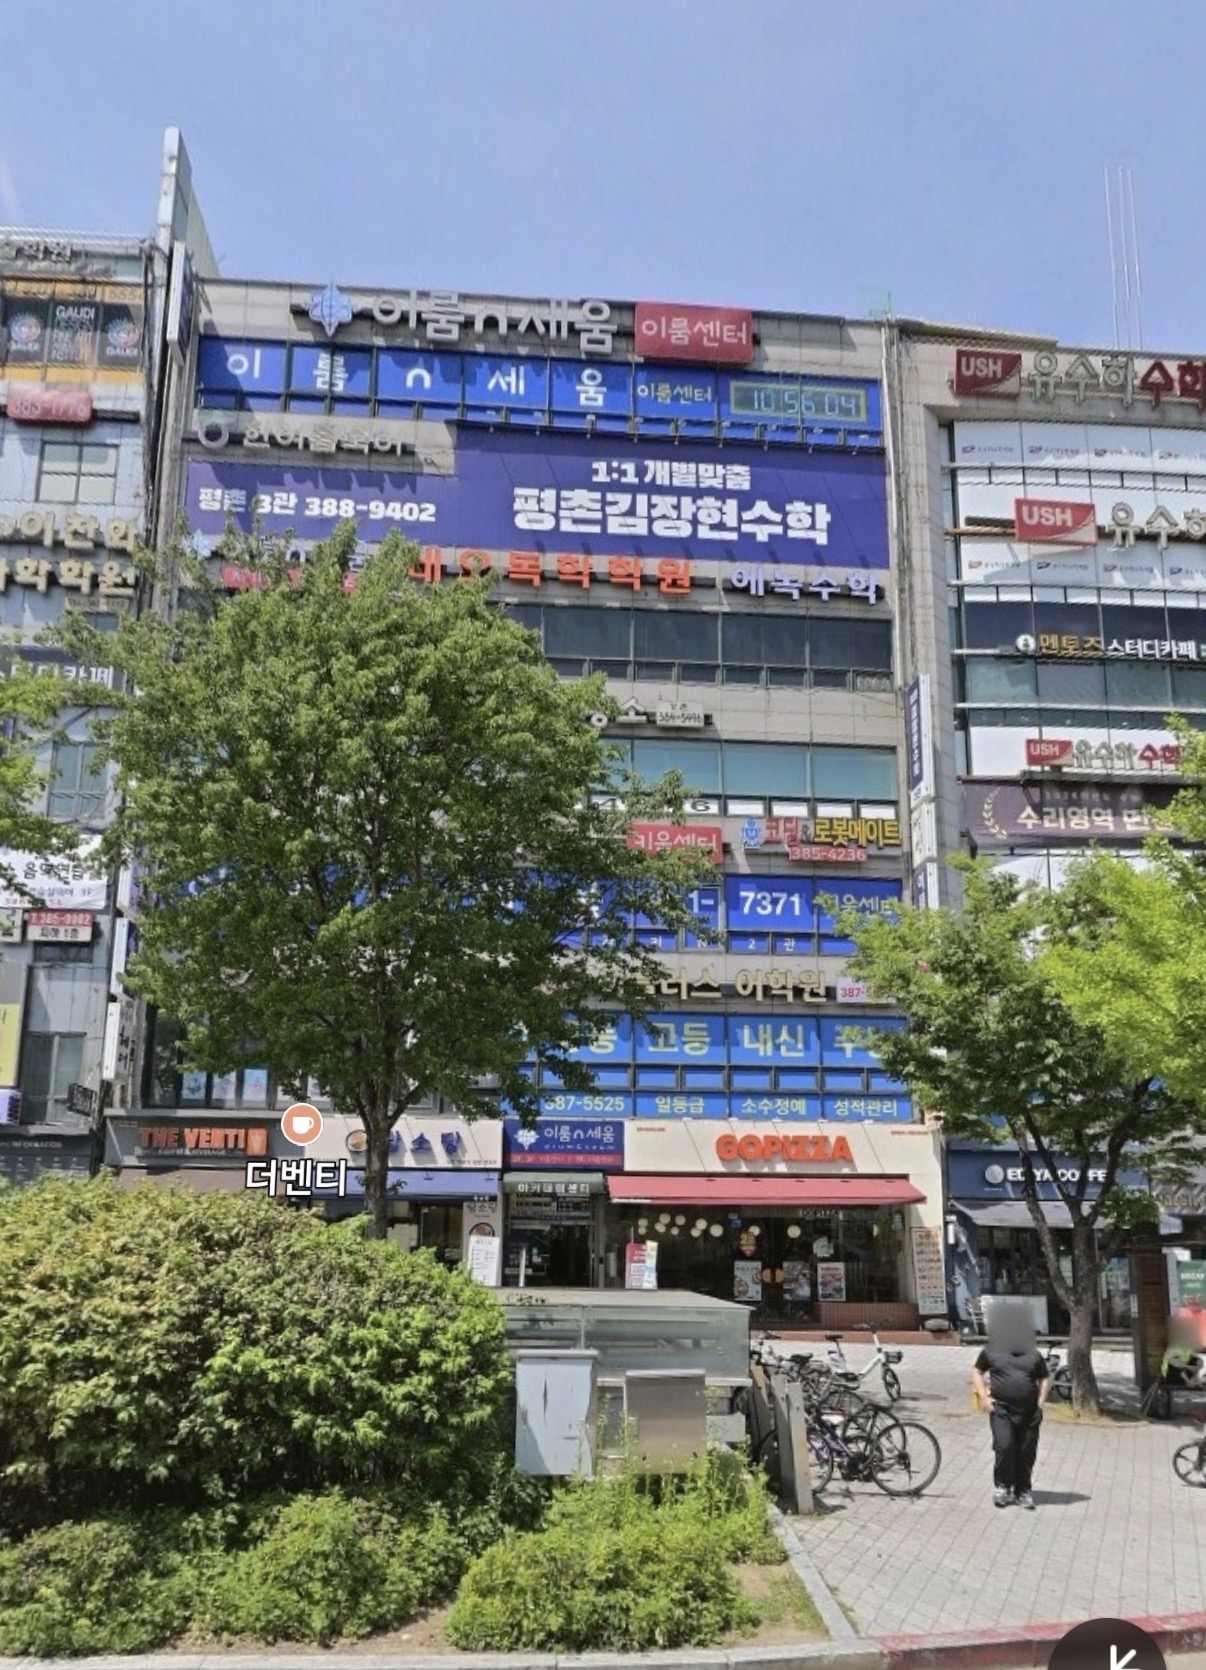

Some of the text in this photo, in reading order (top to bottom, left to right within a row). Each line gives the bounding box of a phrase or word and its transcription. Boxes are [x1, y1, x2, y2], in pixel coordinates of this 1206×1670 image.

[961, 357, 1003, 378] USH
[591, 459, 752, 491] 1:1 개별맞춤
[198, 487, 248, 514] 평촌
[304, 496, 437, 522] 388-9402
[512, 486, 832, 547] 평촌김장현수학
[1021, 504, 1073, 528] USH
[1106, 638, 1199, 662] 스터디카페
[1028, 743, 1061, 757] USH
[1017, 805, 1115, 831] 수리영역
[739, 891, 801, 917] 7371
[735, 967, 828, 1003] 어학원
[647, 1021, 712, 1058] 고등
[742, 1022, 806, 1059] 내신
[544, 1095, 625, 1112] 387-5525
[654, 1095, 898, 1118] 일등급 소수정예 성적관리
[138, 1126, 246, 1149] THE VENTI
[714, 1133, 854, 1162] GOPIZZA
